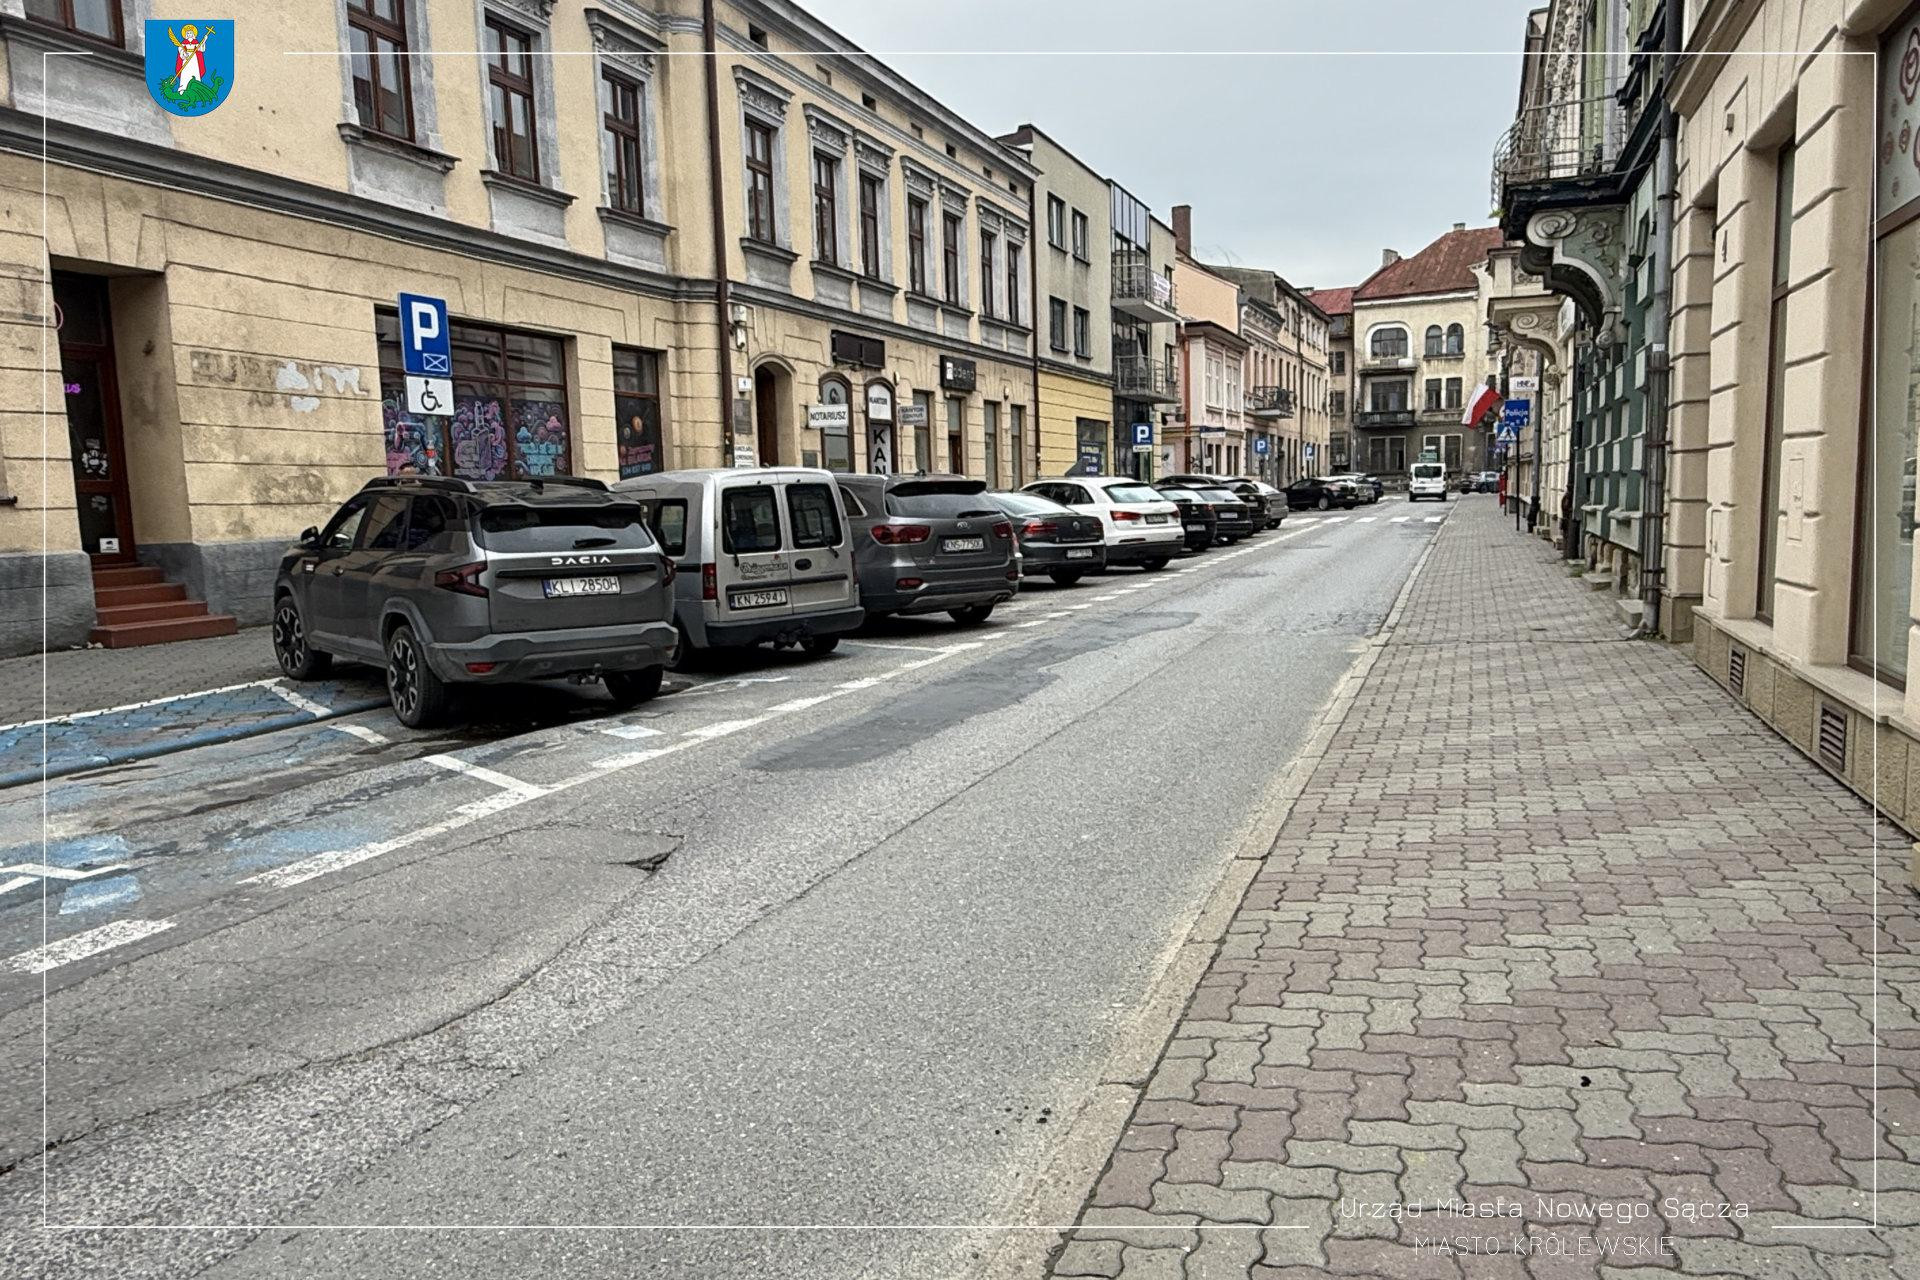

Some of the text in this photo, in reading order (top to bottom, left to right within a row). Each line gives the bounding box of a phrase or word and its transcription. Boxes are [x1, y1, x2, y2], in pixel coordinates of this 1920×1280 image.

[411, 301, 440, 351] P
[869, 396, 888, 405] KANTOR
[809, 410, 847, 421] NOTARIUSZ
[1505, 409, 1529, 418] Policja
[1137, 425, 1150, 443] P
[551, 555, 612, 566] DACIA
[581, 578, 618, 592] 2850H
[737, 594, 752, 606] KN
